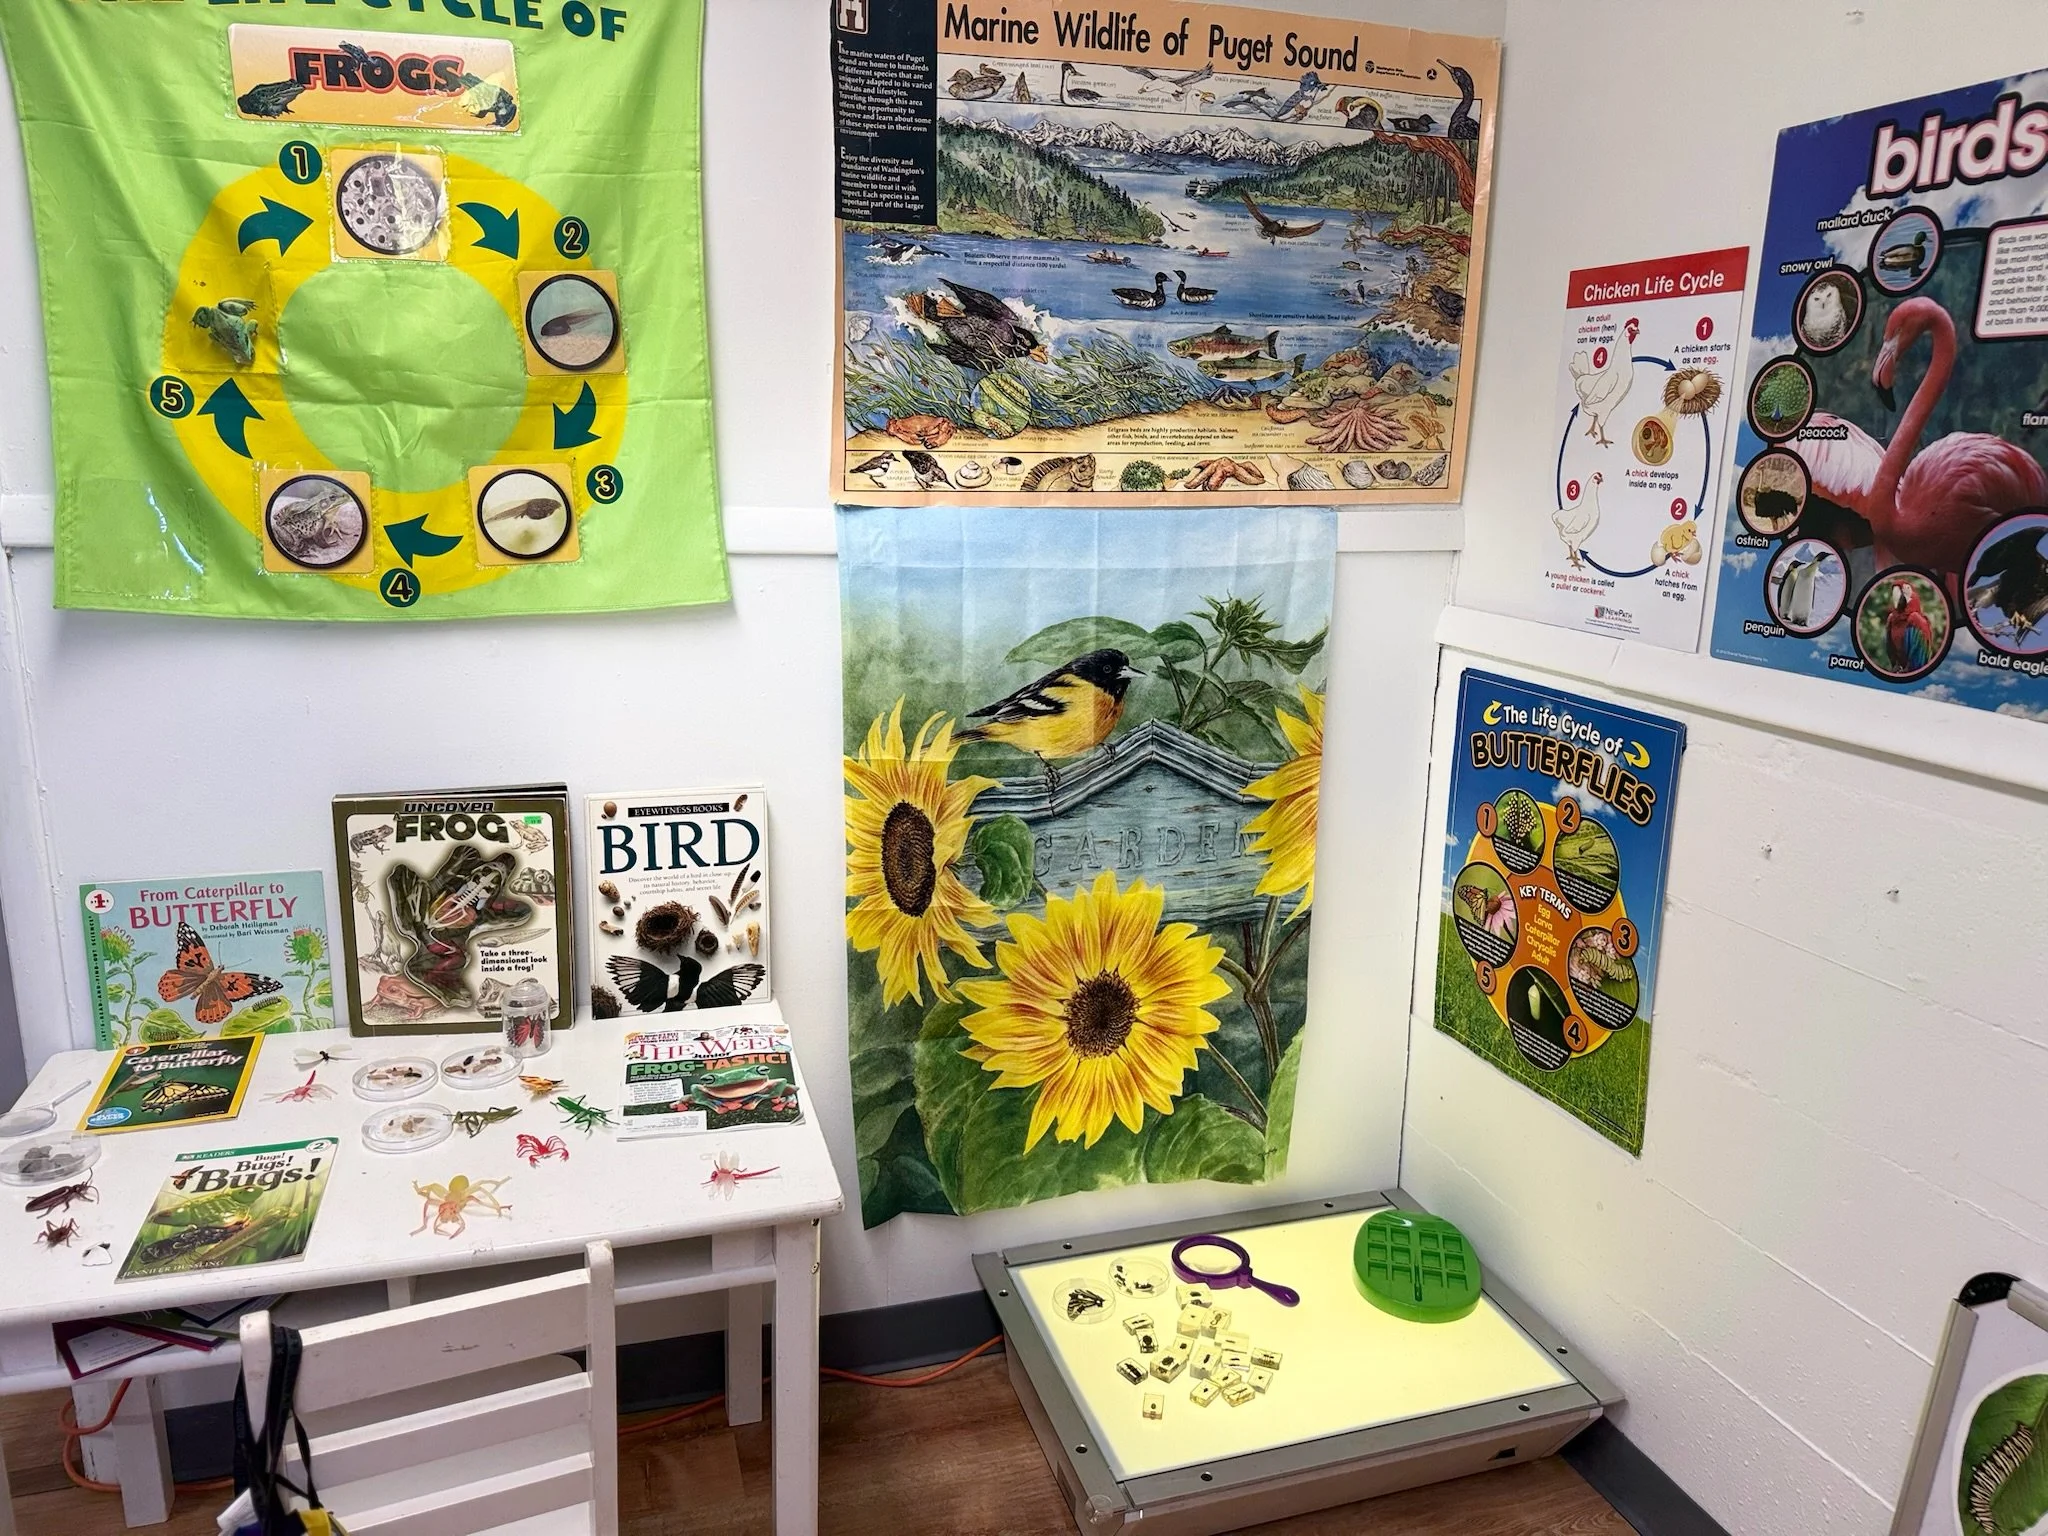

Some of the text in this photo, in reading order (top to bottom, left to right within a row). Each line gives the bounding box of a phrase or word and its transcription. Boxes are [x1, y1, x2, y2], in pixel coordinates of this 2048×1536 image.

[362, 0, 627, 42] CLE OF
[944, 3, 1359, 72] Marine Wildlife of Puget Sound
[869, 59, 888, 68] home
[889, 61, 896, 69] to
[897, 63, 929, 71] hundreds
[874, 52, 896, 60] waters
[905, 54, 925, 64] Puget
[289, 49, 464, 96] FROGS
[845, 66, 872, 76] different
[874, 70, 898, 78] species
[899, 71, 912, 79] that
[1869, 97, 2048, 196] birds
[293, 145, 311, 180] 1
[840, 146, 914, 166] Enjoy the diversity and
[881, 165, 925, 176] Washington's
[1817, 209, 1892, 231] mallard duck
[561, 222, 582, 252] 2
[1780, 257, 1834, 275] snowy owl
[1584, 270, 1725, 302] Chicken Life Cycle
[1586, 314, 1611, 323] An adult
[1578, 323, 1617, 334] chicken (hen)
[1701, 322, 1708, 336] 1
[1577, 335, 1615, 345] can lay eggs.
[1674, 343, 1731, 354] A chicken starts
[1596, 351, 1604, 363] 4
[1692, 356, 1701, 364] an
[1703, 356, 1719, 365] egg.
[160, 382, 184, 412] 5
[1799, 426, 1847, 440] peacock
[1625, 469, 1679, 482] A chick develops
[596, 470, 616, 499] 3
[1569, 484, 1577, 496] 3
[1629, 479, 1647, 488] inside
[1658, 482, 1673, 492] egg.
[1675, 502, 1683, 516] 2
[1736, 535, 1769, 548] ostrich
[1551, 573, 1567, 583] young
[1568, 574, 1590, 584] chicken
[1597, 578, 1615, 588] called
[1665, 569, 1690, 579] A chick
[388, 574, 412, 602] 4
[1556, 582, 1571, 592] pullet
[1580, 586, 1606, 597] cockerel.
[1655, 578, 1698, 592] hatches from
[1662, 590, 1687, 602] an egg.
[1745, 622, 1785, 637] penguin
[1830, 655, 1865, 670] parrot
[1979, 652, 2011, 668] bald
[1503, 705, 1624, 756] The Life Cycle of
[1471, 731, 1656, 826] BUTTERFLIES
[403, 801, 494, 813] UNCOVER
[634, 804, 724, 816] EYEWITNESS BOOKS
[1483, 808, 1490, 830] 1
[1561, 802, 1575, 829] 2
[396, 814, 509, 843] FROG
[597, 818, 760, 874] BIRD
[140, 883, 285, 902] From Caterpillar to
[93, 893, 106, 909] 1
[1519, 885, 1538, 898] KEY
[1539, 887, 1572, 920] TERMS
[129, 896, 298, 930] BUTTERFLY
[1538, 903, 1551, 920] Egg
[209, 922, 239, 931] Deborah
[242, 921, 278, 929] Heiligman
[1533, 914, 1553, 931] Larva
[253, 928, 289, 936] Weissman
[1525, 922, 1560, 946] Caterpillar
[1617, 923, 1631, 950] 3
[480, 950, 499, 958] Take
[508, 949, 533, 957] three-
[1526, 935, 1557, 958] Chrysalis
[481, 956, 548, 965] dimensional look
[1531, 950, 1551, 966] Adult
[514, 963, 534, 972] frog!
[1482, 966, 1490, 987] 5
[1567, 1022, 1581, 1046] 4
[628, 1036, 783, 1060] THE WEEK
[125, 1049, 228, 1066] Caterpillar
[135, 1055, 244, 1073] to Butterfly
[630, 1053, 787, 1076] FROG-TASTIC!
[313, 1142, 325, 1150] 2
[196, 1150, 235, 1160] READERS
[255, 1152, 286, 1162] Bugs!
[235, 1155, 294, 1173] Bugs!
[190, 1157, 322, 1194] Bugs!
[121, 1266, 170, 1277] JENNIFER
